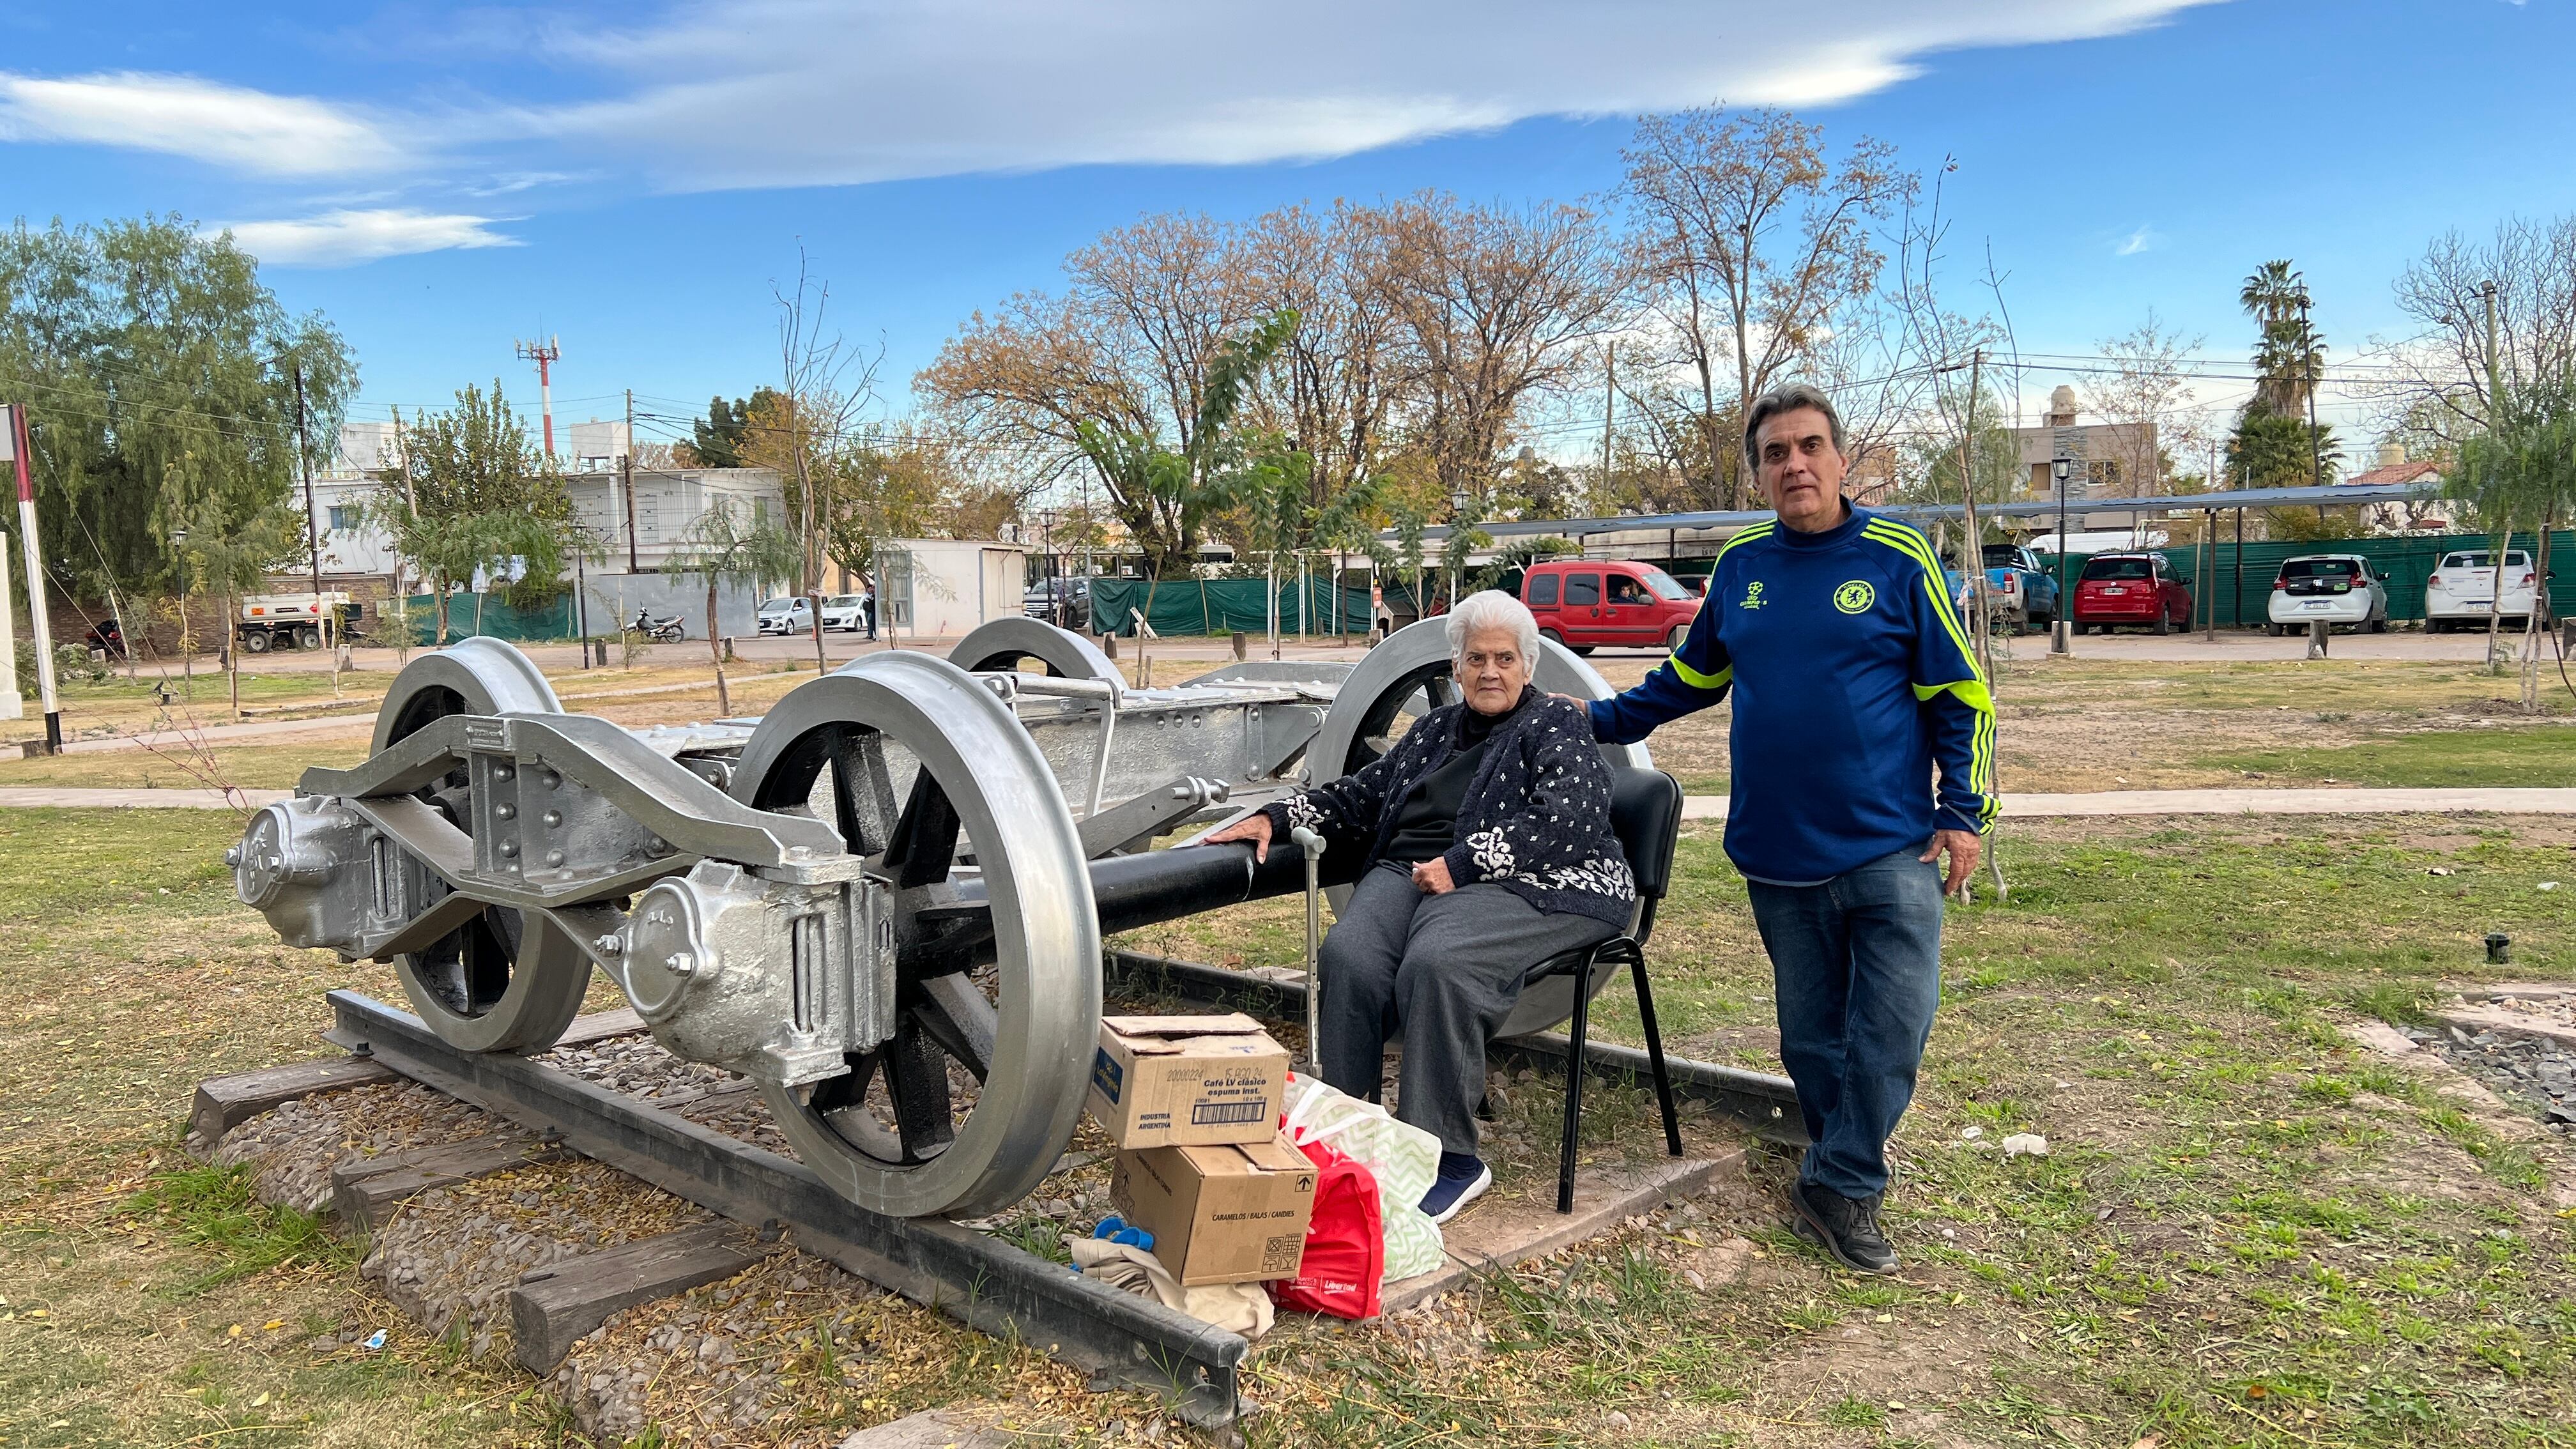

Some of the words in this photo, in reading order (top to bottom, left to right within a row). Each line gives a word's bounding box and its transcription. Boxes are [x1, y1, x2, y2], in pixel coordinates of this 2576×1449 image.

[1208, 1089, 1240, 1097] espuma
[1212, 1212, 1246, 1222] CARAMELOS
[1250, 1211, 1268, 1220] BALAS
[1271, 1210, 1295, 1218] CANDIES
[1324, 1280, 1358, 1292] Libertad
